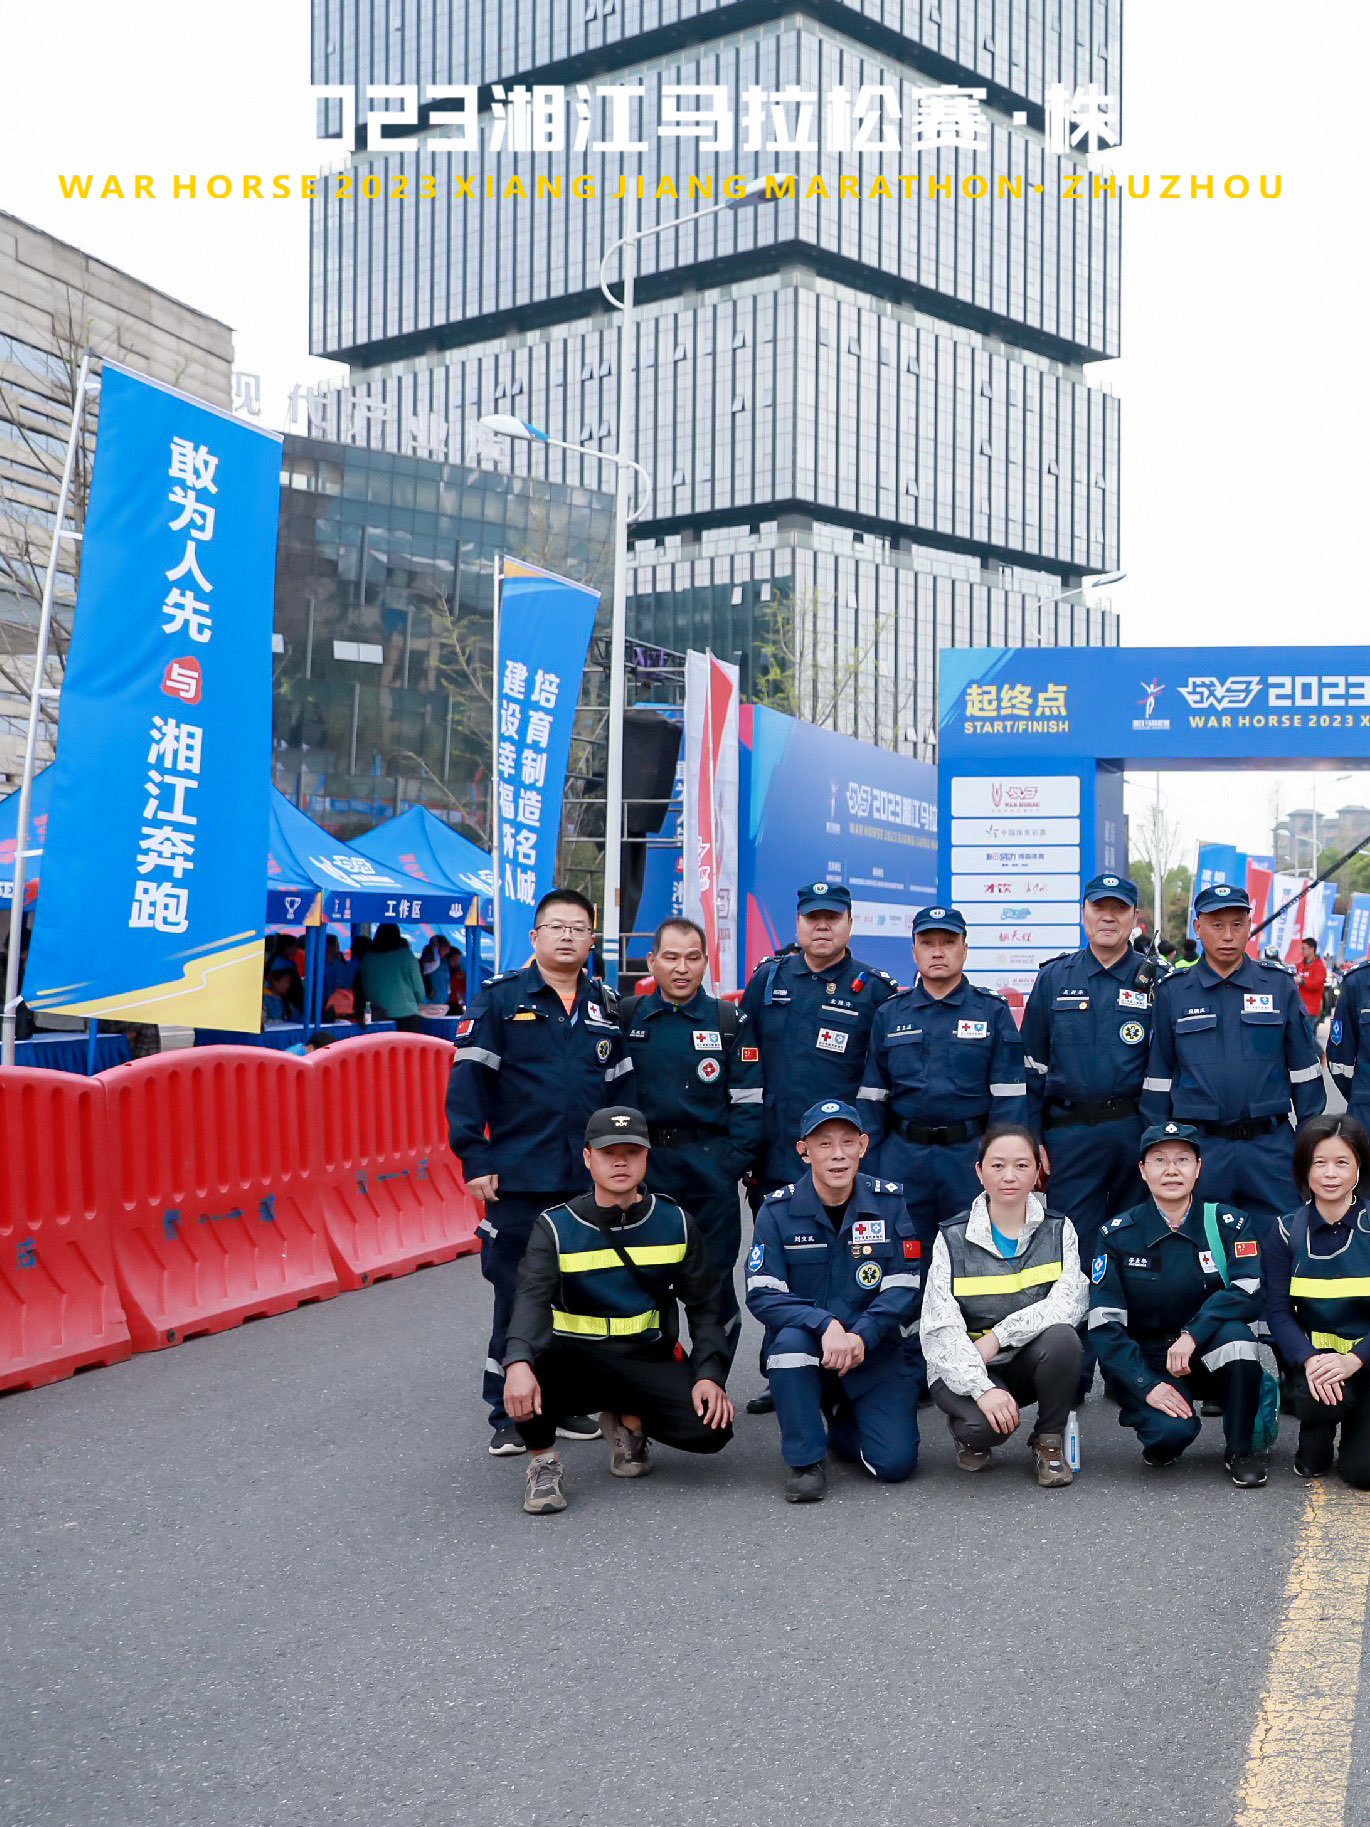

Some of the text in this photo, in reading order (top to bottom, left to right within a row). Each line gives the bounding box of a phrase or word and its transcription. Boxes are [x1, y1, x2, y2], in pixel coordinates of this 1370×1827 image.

[128, 436, 219, 933] 敢为人先 与 湘江奔跑
[965, 683, 1068, 717] 起终点
[964, 721, 1069, 733] START/FINISH
[1189, 715, 1232, 728] WAR
[1238, 715, 1302, 728] HORSE
[1308, 715, 1354, 727] 2023
[514, 669, 561, 906] 培育制造名城
[384, 898, 422, 919] 工作区
